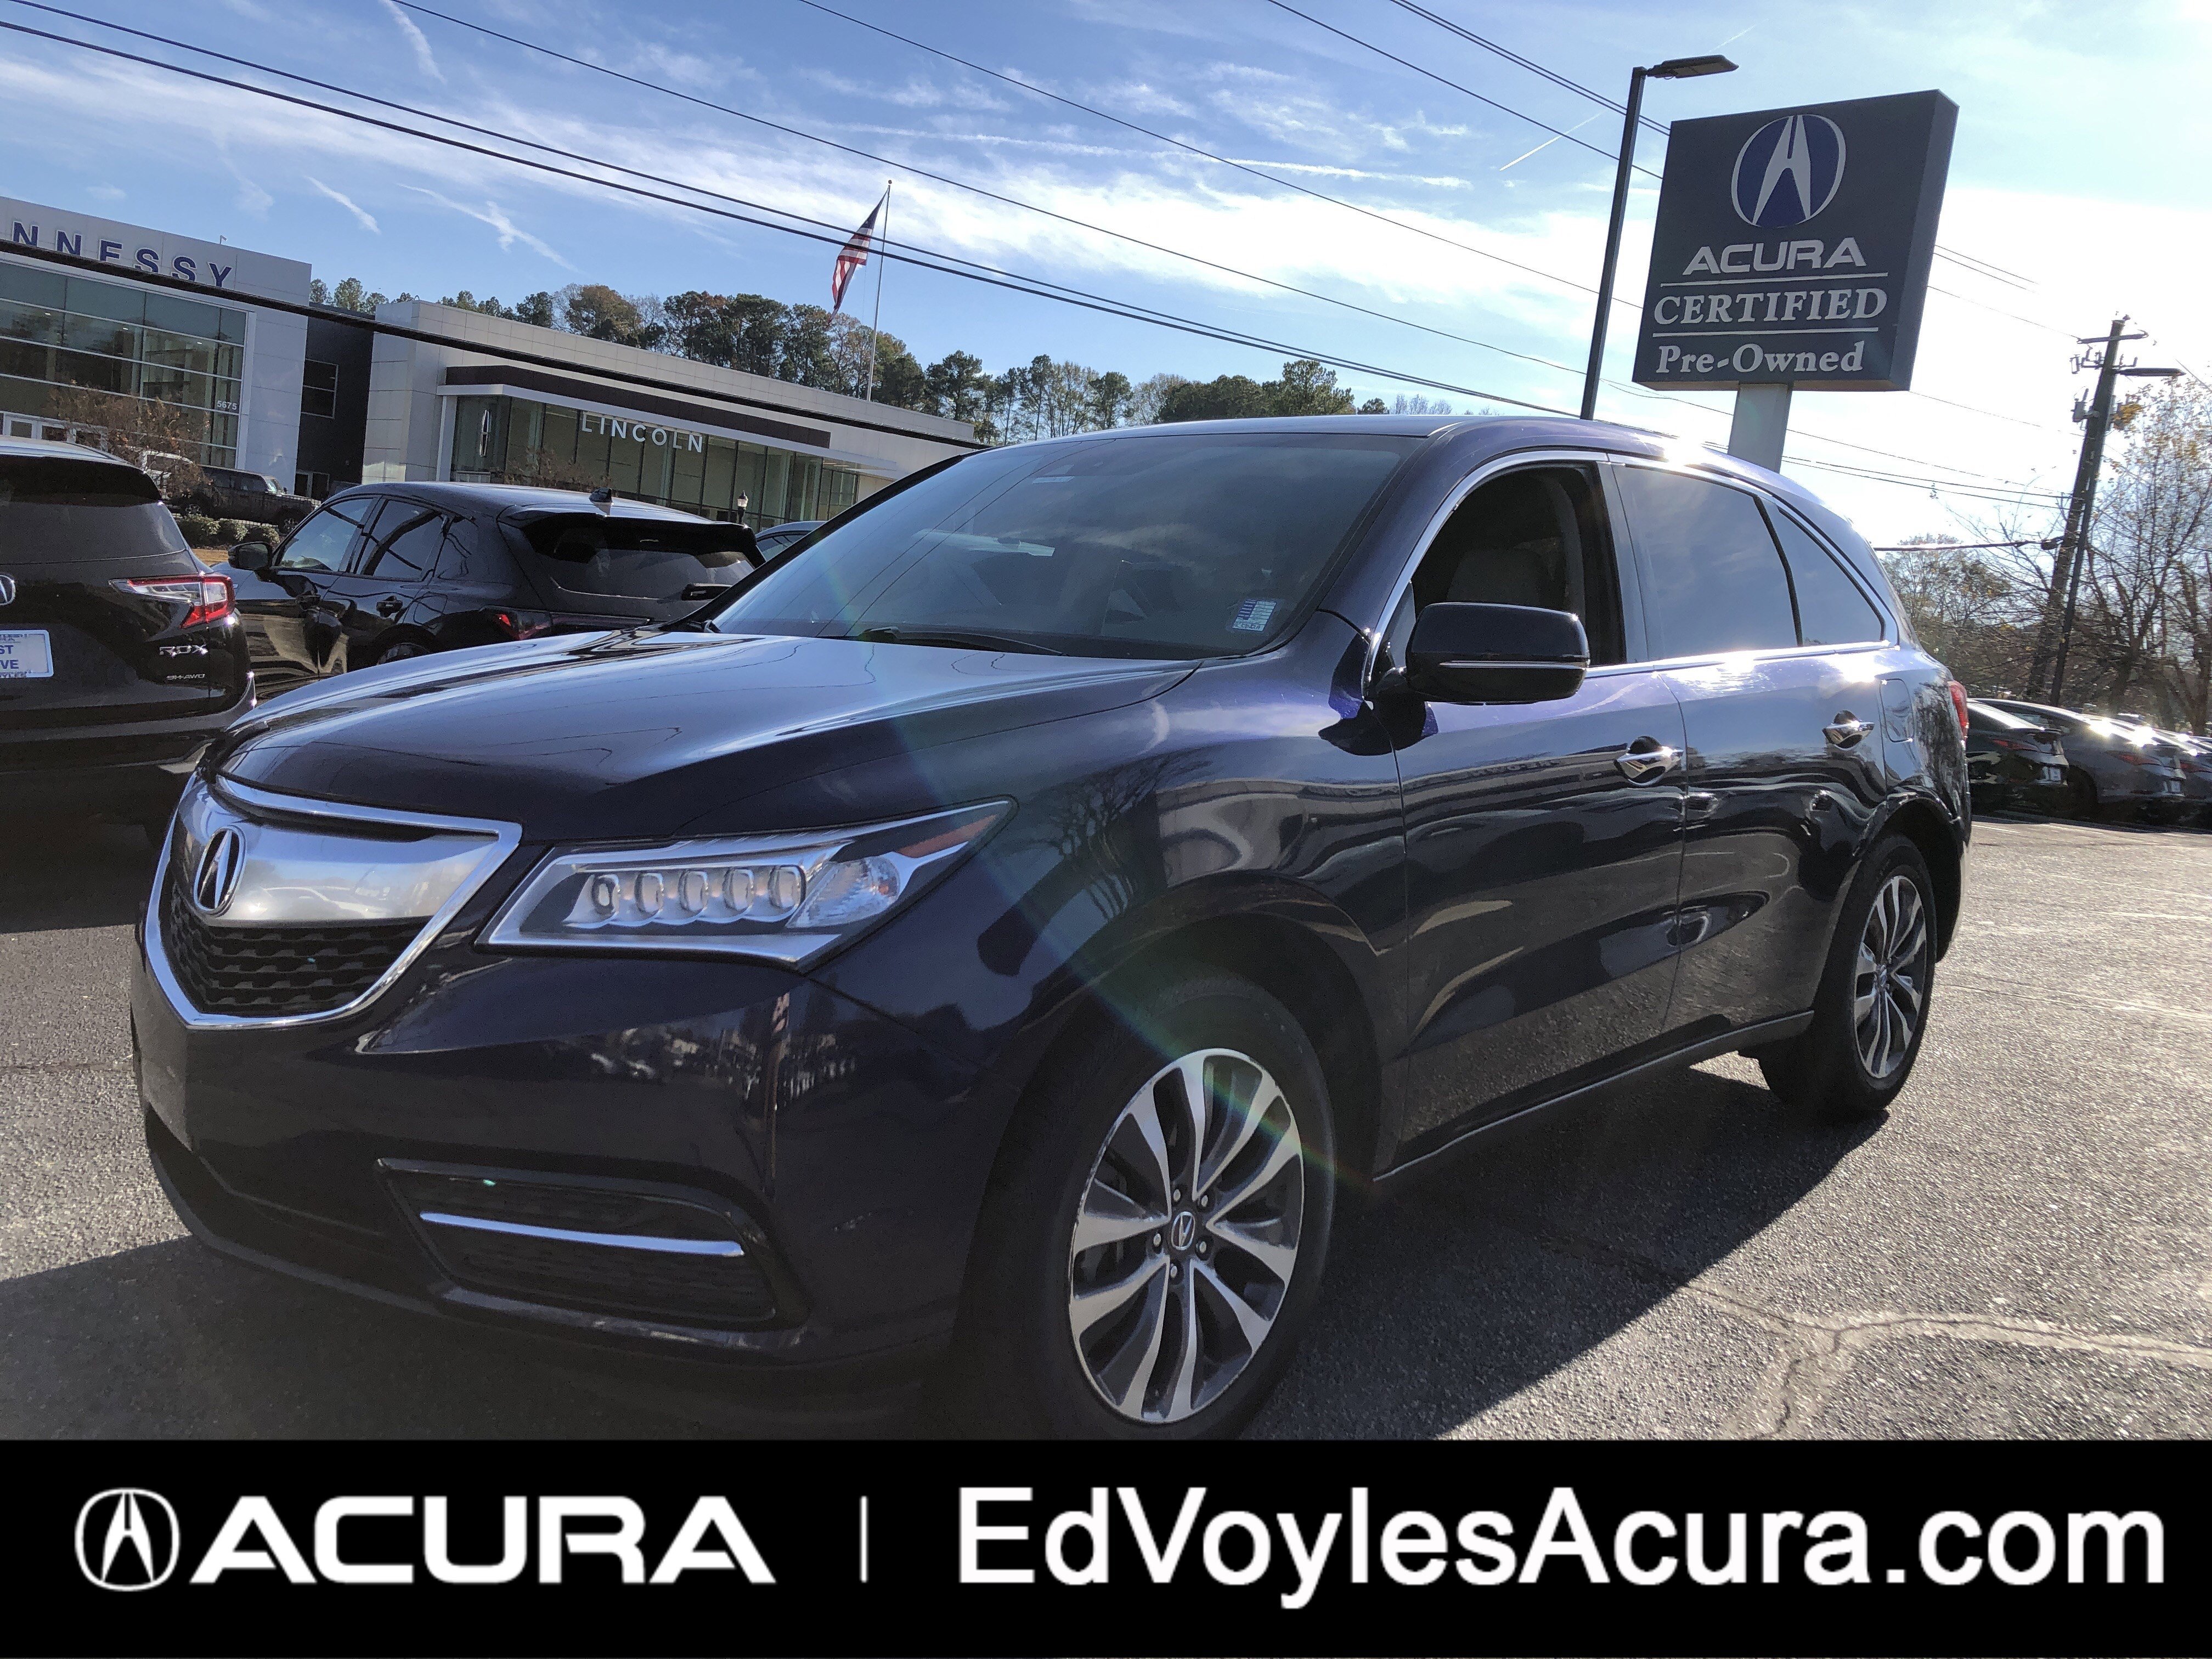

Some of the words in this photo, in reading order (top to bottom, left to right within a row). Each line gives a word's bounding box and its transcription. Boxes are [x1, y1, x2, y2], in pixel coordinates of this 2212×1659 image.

[1682, 236, 1866, 276] ACURA
[1654, 288, 1888, 325] CERTIFIED
[1655, 340, 1865, 374] Pre-Owned
[217, 400, 238, 410] 5675
[582, 411, 703, 453] LINCOLN
[159, 644, 208, 657] RDX
